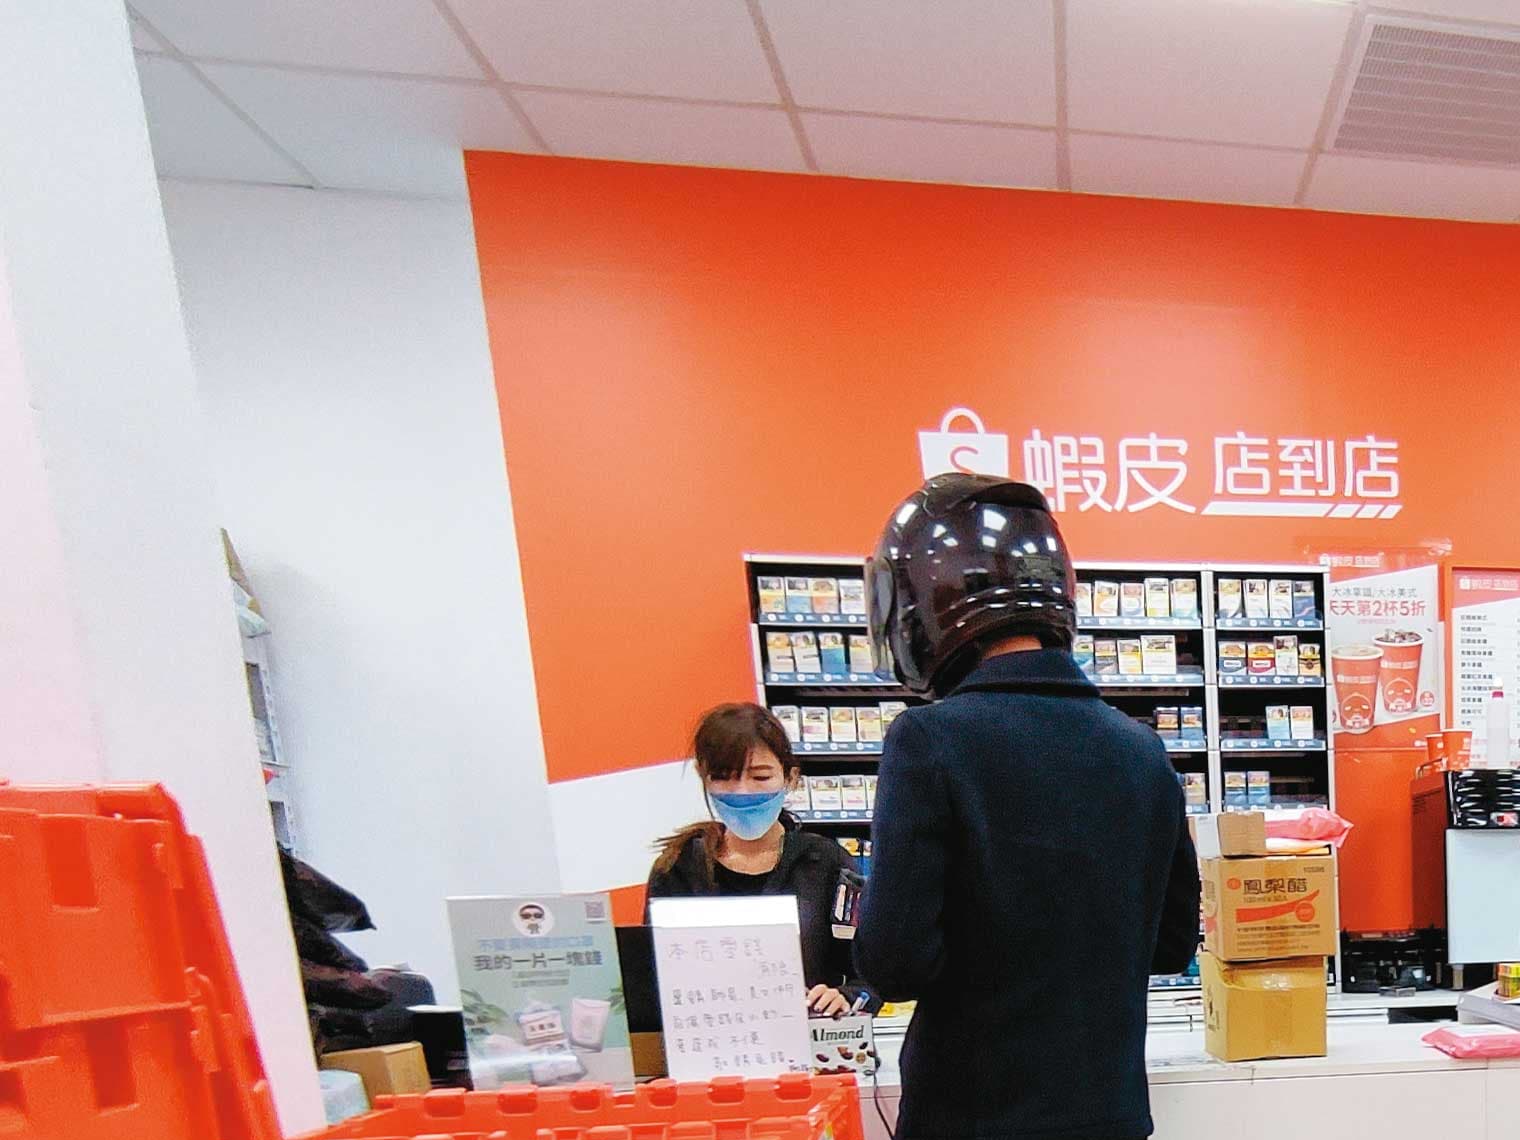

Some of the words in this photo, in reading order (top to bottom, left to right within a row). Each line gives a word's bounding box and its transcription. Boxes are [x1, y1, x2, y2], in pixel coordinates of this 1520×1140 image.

[1023, 429, 1197, 513] 蝦皮
[1213, 431, 1401, 499] 店到店
